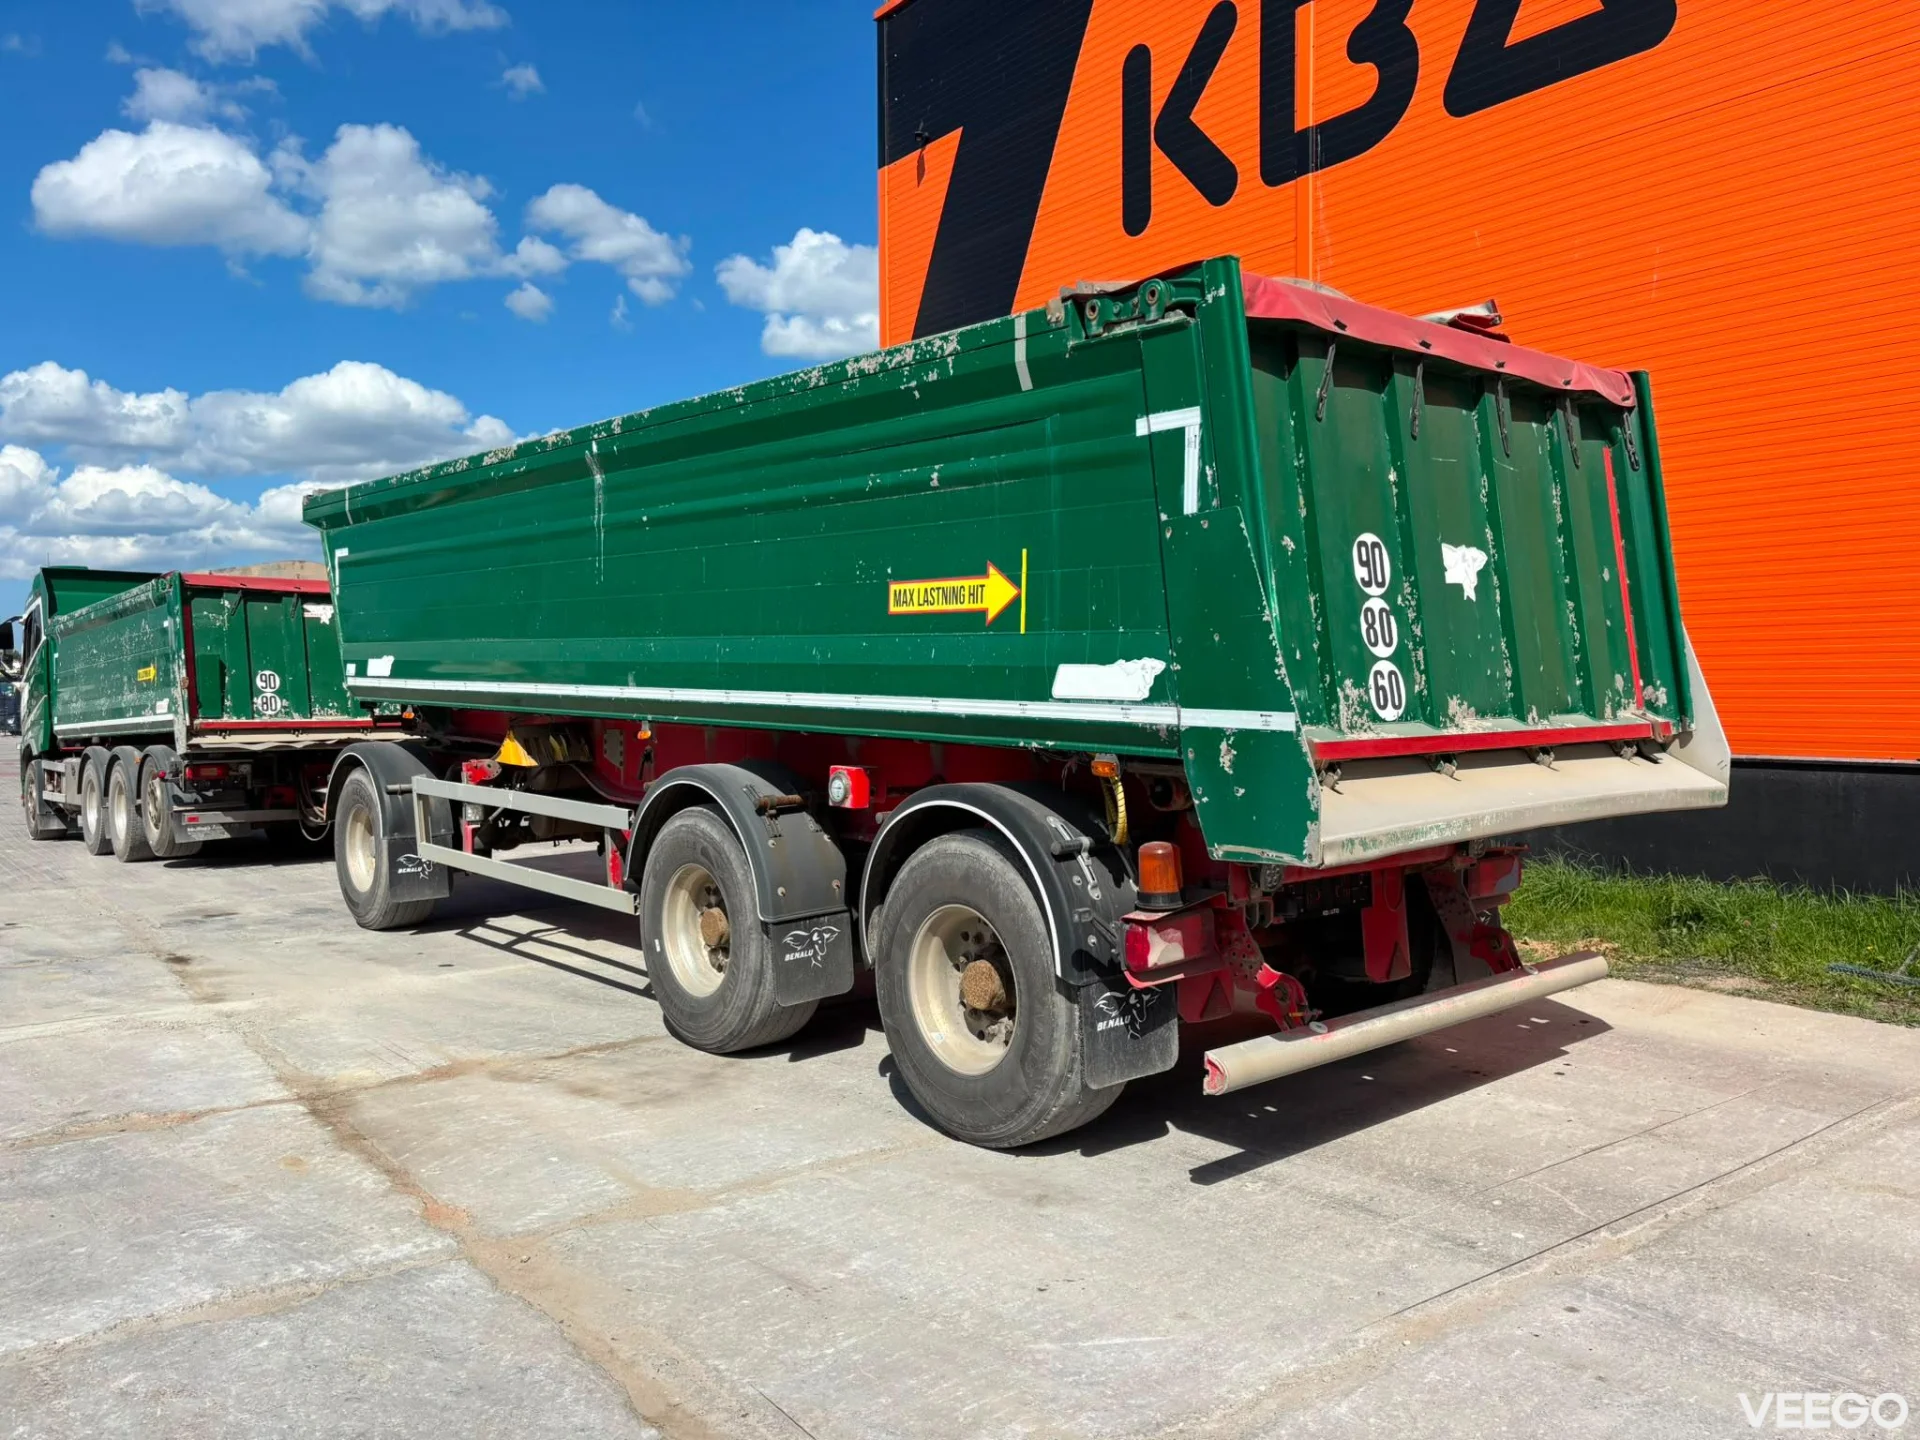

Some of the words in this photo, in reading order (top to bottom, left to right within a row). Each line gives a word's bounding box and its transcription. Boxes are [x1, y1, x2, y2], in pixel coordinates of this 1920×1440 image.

[1356, 540, 1387, 589] 90
[893, 588, 915, 607] MAX
[917, 585, 966, 607] LASTNING
[968, 584, 986, 605] HIT
[1363, 606, 1394, 648] 80
[260, 673, 277, 690] 90
[1373, 669, 1403, 711] 60
[261, 695, 277, 712] 80
[784, 949, 814, 962] BENALU
[1096, 1015, 1131, 1032] BENALU
